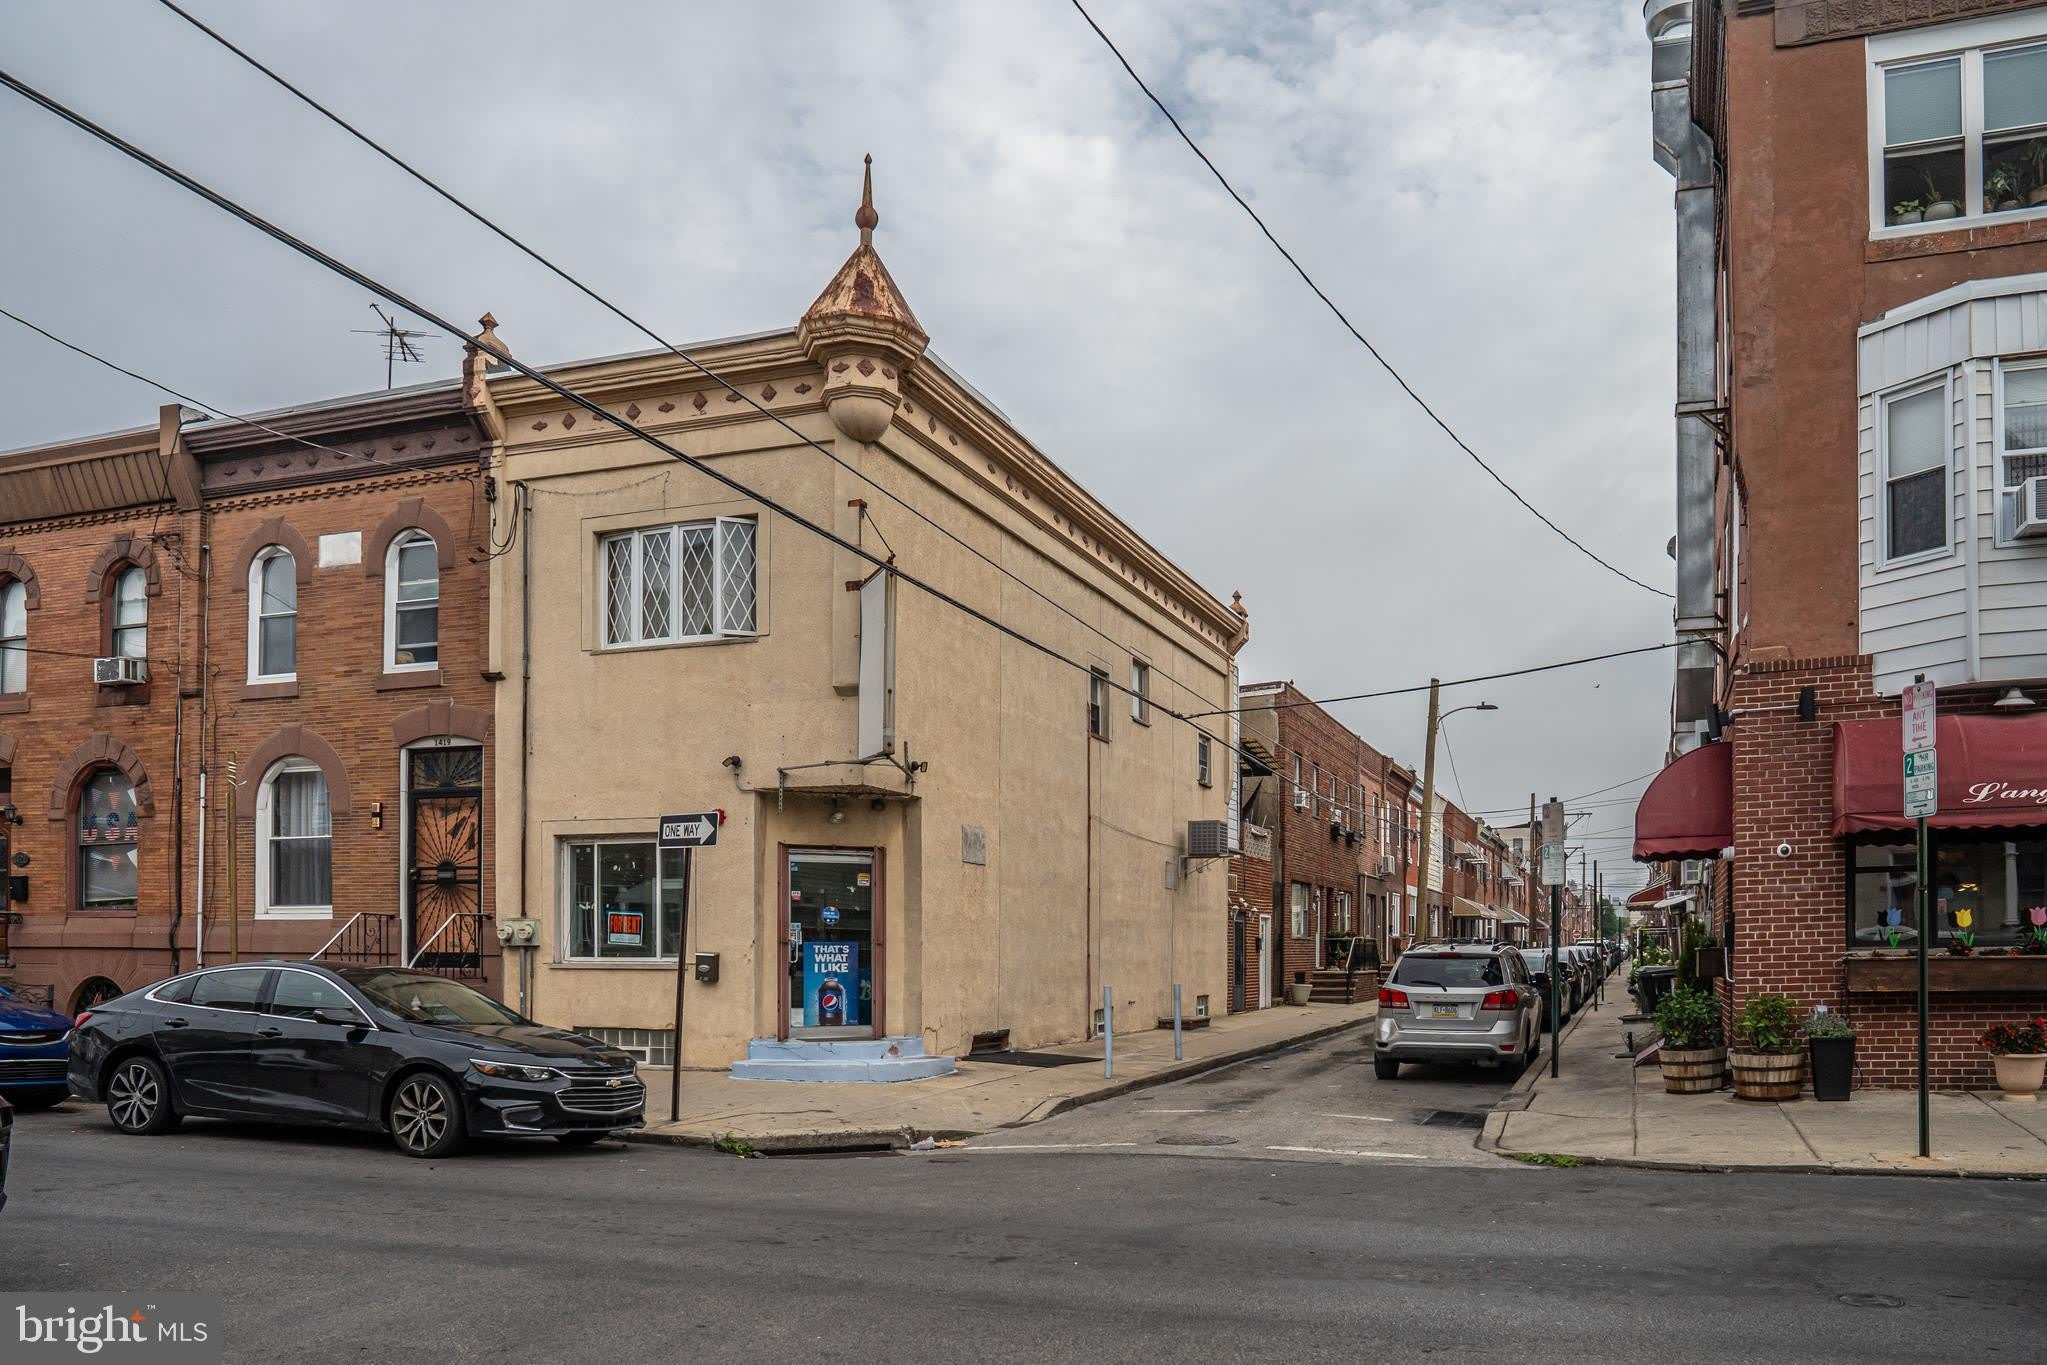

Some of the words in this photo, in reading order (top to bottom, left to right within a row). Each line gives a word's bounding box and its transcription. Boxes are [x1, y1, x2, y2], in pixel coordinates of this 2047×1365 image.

[1912, 709, 1926, 721] ANY
[1912, 721, 1927, 734] TIME
[434, 738, 451, 746] 1419
[1906, 757, 1912, 774] 2
[1914, 761, 1934, 774] PARKING
[82, 811, 138, 843] USA
[665, 824, 681, 837] ONE
[683, 823, 700, 837] WAY
[610, 914, 623, 932] FOR
[623, 915, 640, 933] RENT
[813, 945, 849, 953] THAT'S
[814, 953, 849, 962] WHAT
[814, 963, 819, 973] I
[821, 963, 849, 973] LIKE
